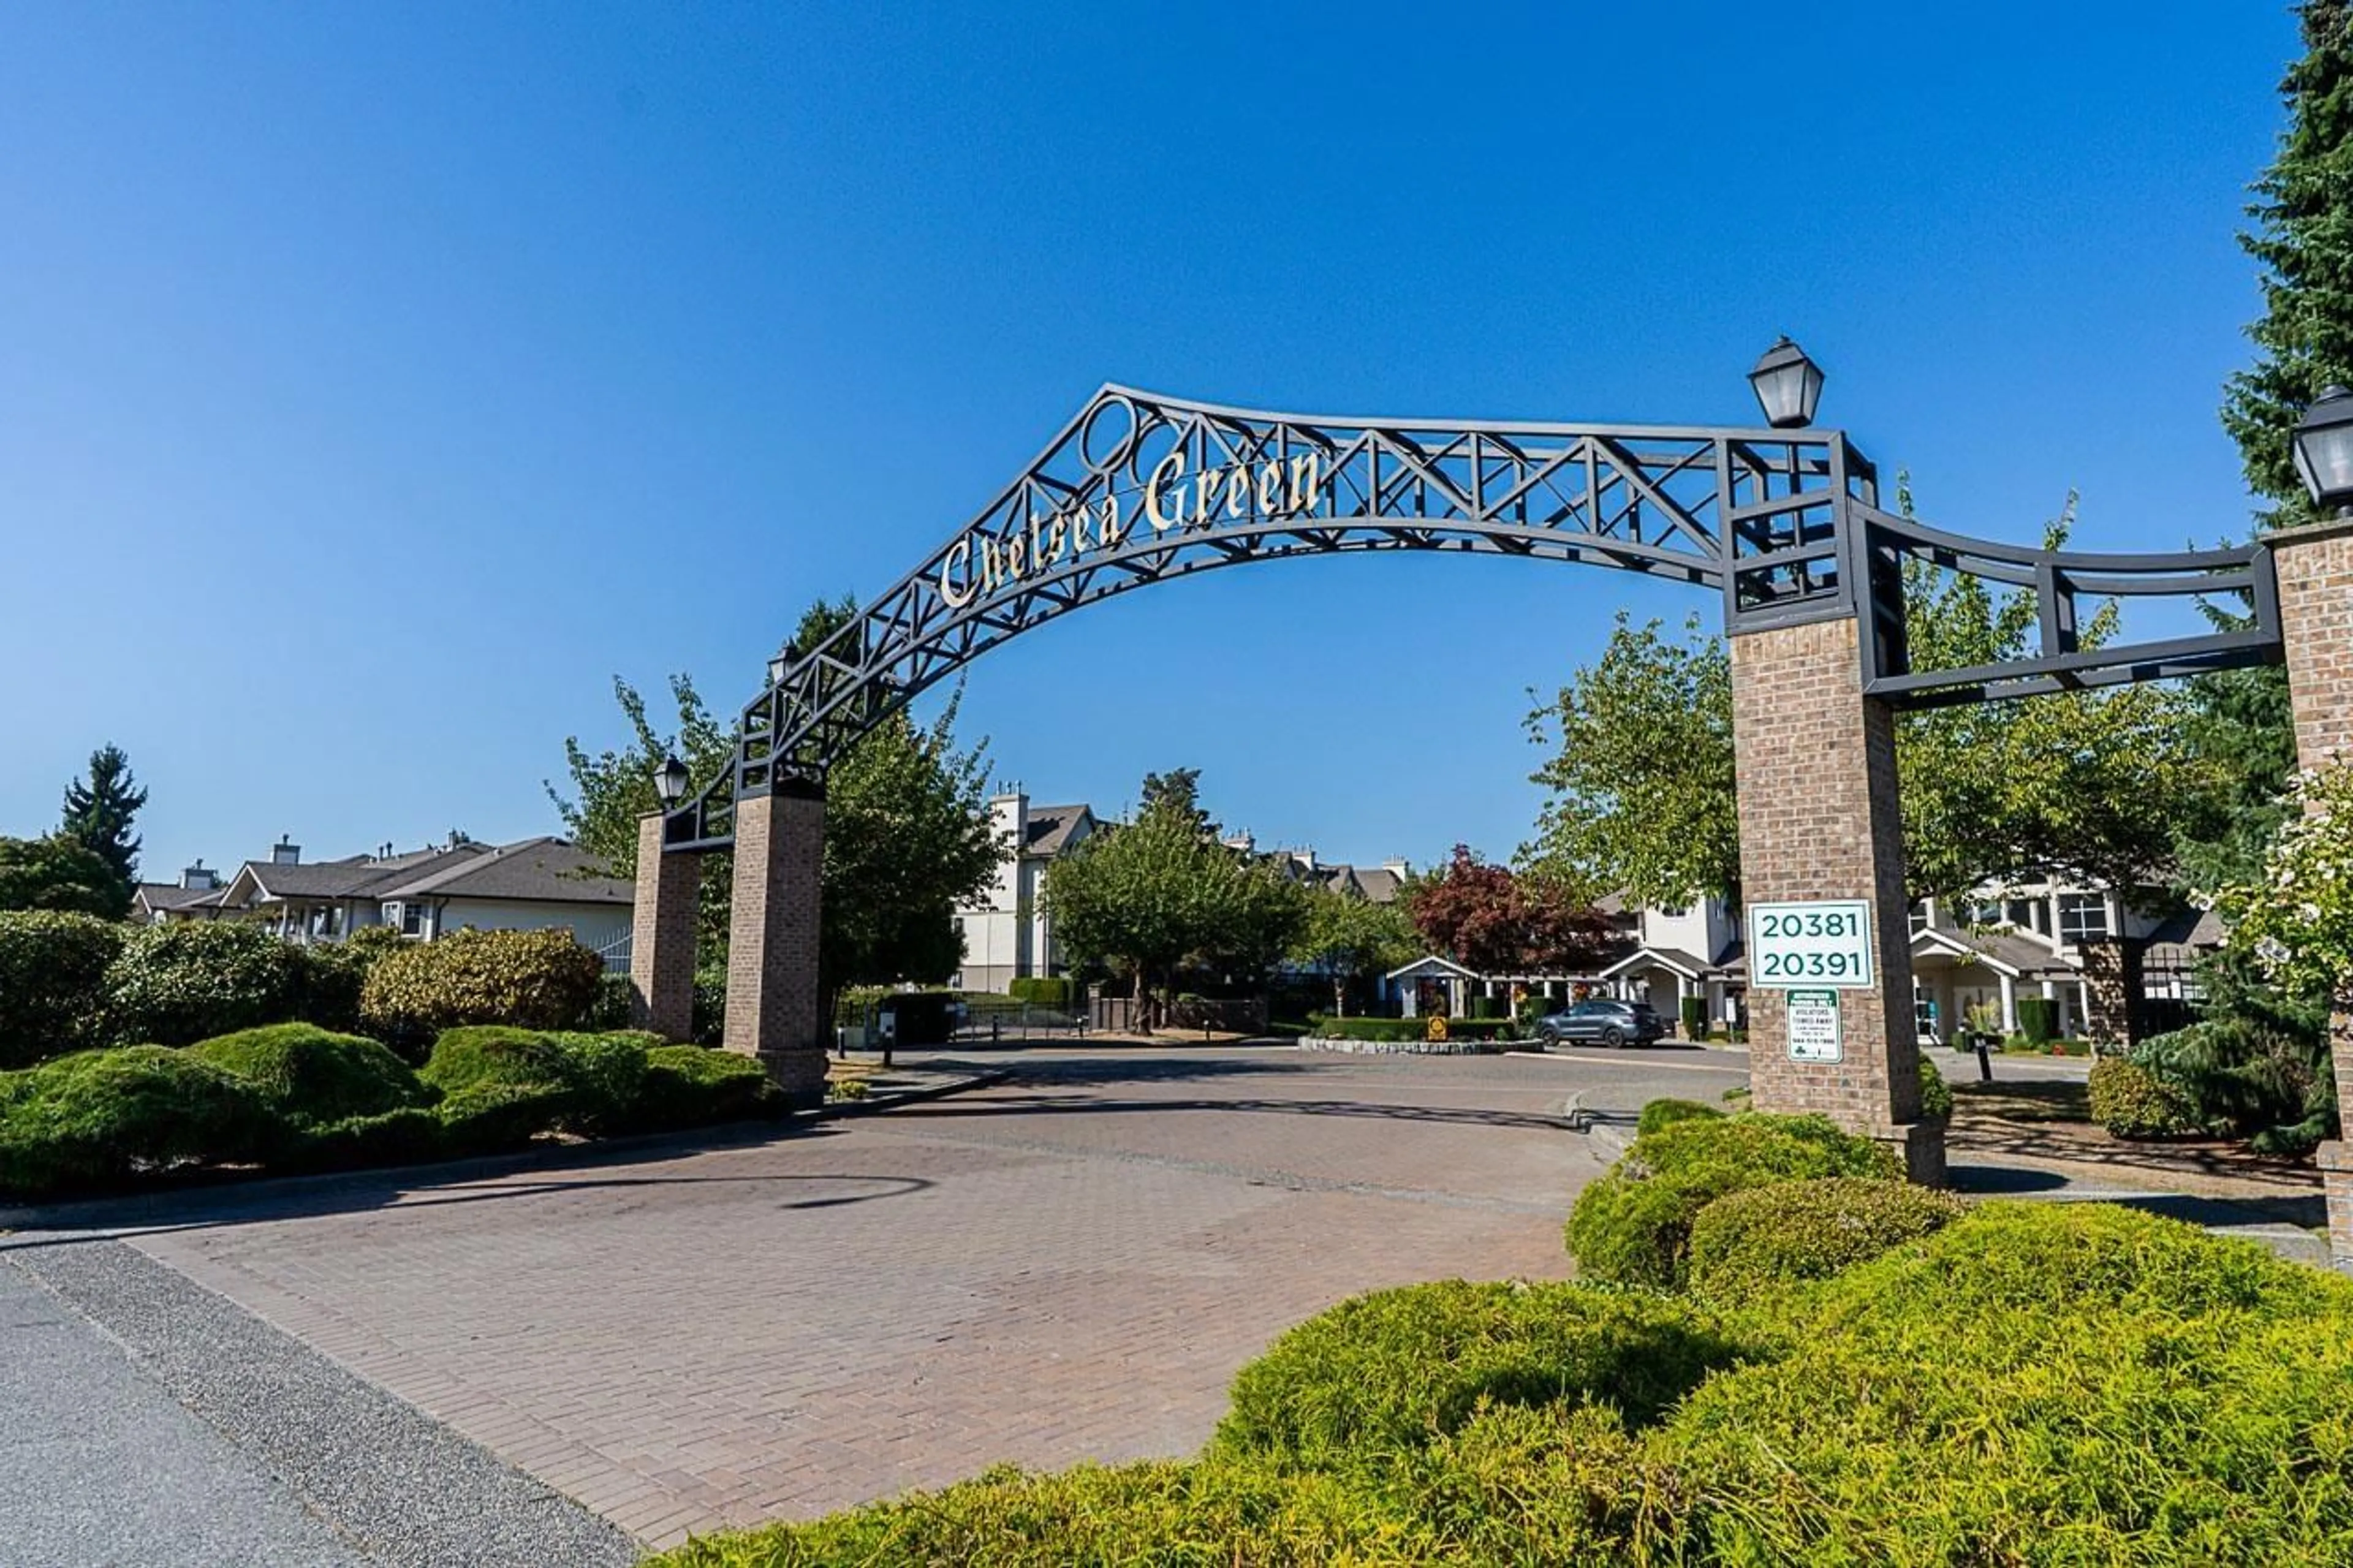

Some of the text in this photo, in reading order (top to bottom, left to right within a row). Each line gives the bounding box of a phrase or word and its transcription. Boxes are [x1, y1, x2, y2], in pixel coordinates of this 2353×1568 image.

[941, 452, 1319, 607] Chelsea Green
[1762, 914, 1857, 937] 20381
[1764, 952, 1860, 976] 20391
